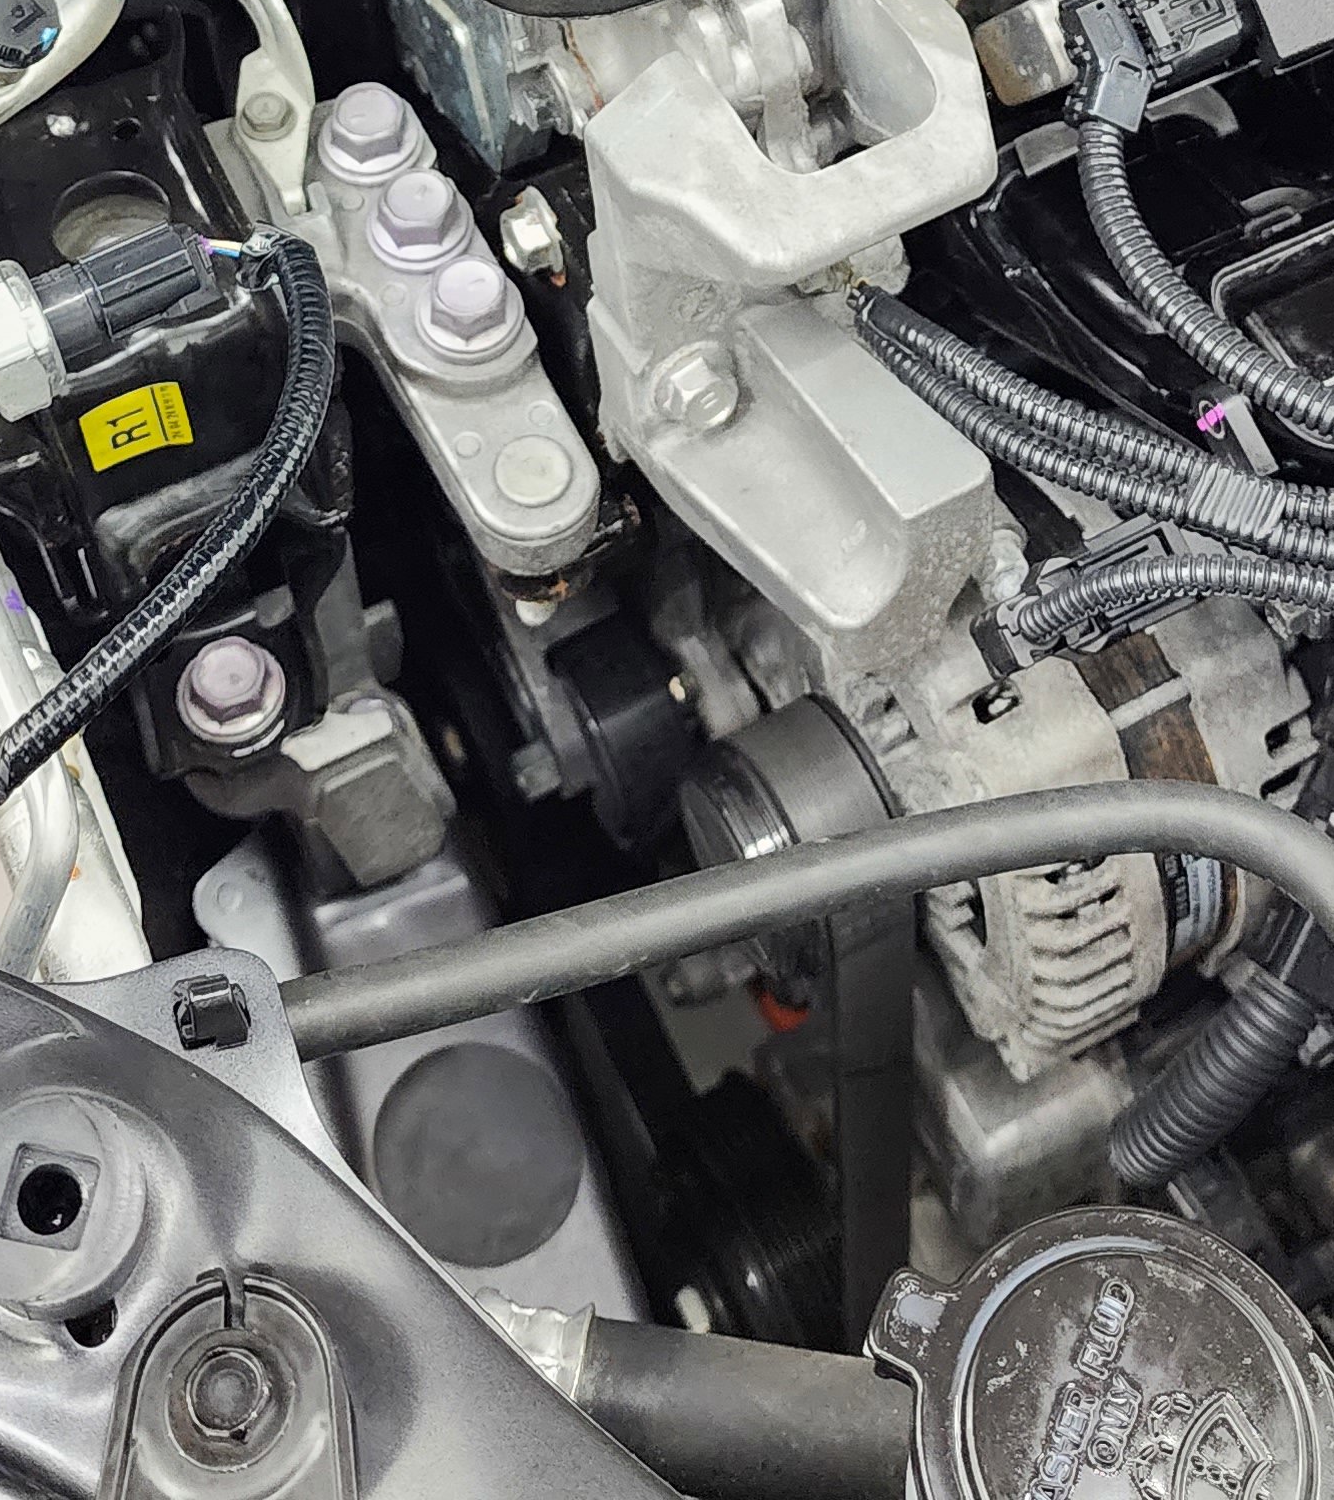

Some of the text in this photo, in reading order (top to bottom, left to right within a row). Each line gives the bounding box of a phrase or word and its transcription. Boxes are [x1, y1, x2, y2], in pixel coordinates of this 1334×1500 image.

[106, 406, 152, 450] R1
[1029, 1279, 1135, 1500] ASHER FLUID
[1087, 1372, 1143, 1475] ONLY
